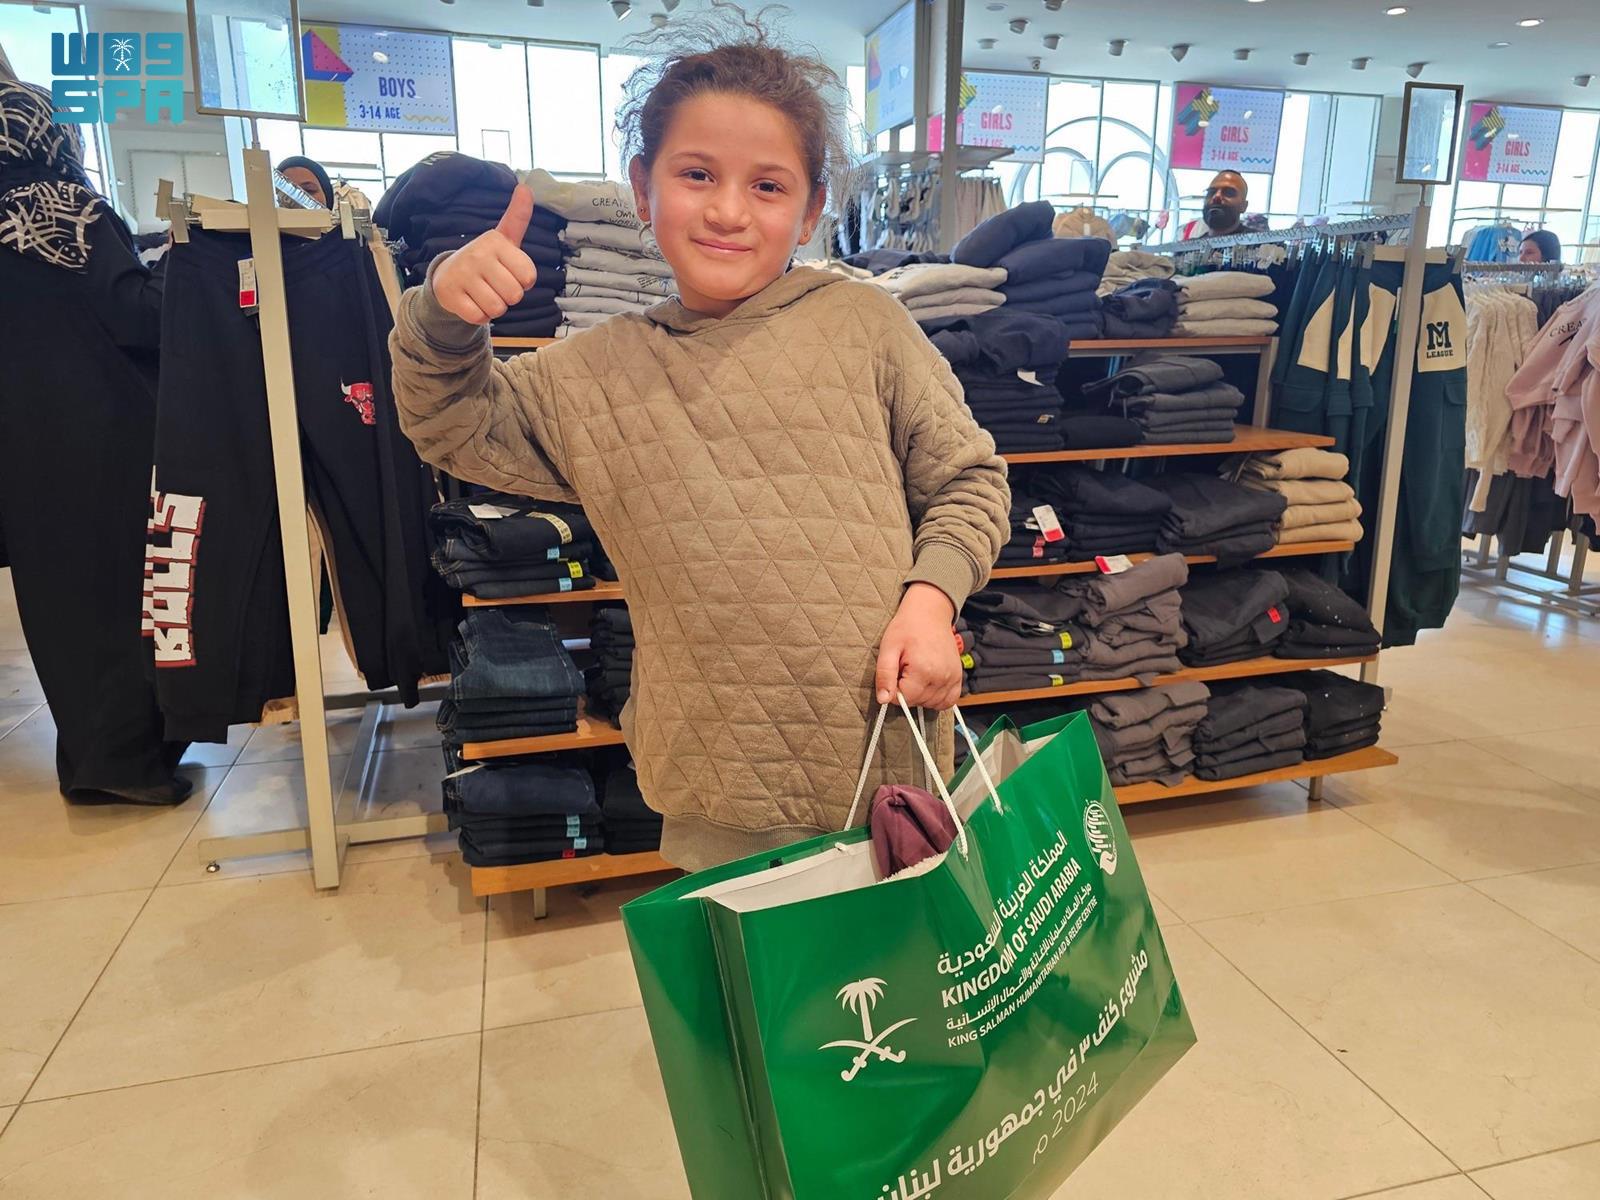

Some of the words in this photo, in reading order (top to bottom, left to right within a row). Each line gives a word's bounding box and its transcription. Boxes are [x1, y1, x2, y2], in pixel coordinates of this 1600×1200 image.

[378, 76, 416, 98] BOYS
[359, 104, 381, 119] 3-14
[385, 107, 401, 119] AGE
[981, 112, 1012, 130] GIRLS
[1220, 125, 1249, 143] GIRLS
[1504, 141, 1531, 157] GIRLS
[1511, 164, 1520, 174] AGE
[1426, 350, 1454, 359] LEAGUE
[1028, 830, 1068, 879] المملكة
[998, 871, 1036, 919] العربية
[1077, 883, 1092, 904] مركز
[937, 909, 1004, 977] السعودية
[941, 943, 1018, 1008] KINGDOM
[1011, 925, 1028, 952] OF
[1024, 892, 1055, 936] SAUDI
[1050, 857, 1081, 903] ARABIA
[948, 1030, 978, 1048] KING
[979, 1003, 1016, 1037] SALMAN
[1016, 951, 1059, 1008] HUMANITARIAN
[1058, 941, 1067, 958] AID
[1068, 916, 1083, 941] RELIEF
[1081, 895, 1098, 921] CENTRE
[1120, 949, 1148, 1017] مشروع
[1093, 998, 1120, 1046] كنف
[1048, 1048, 1078, 1104] في
[1052, 1071, 1099, 1139] 2024
[947, 1088, 1046, 1176] جمهورية
